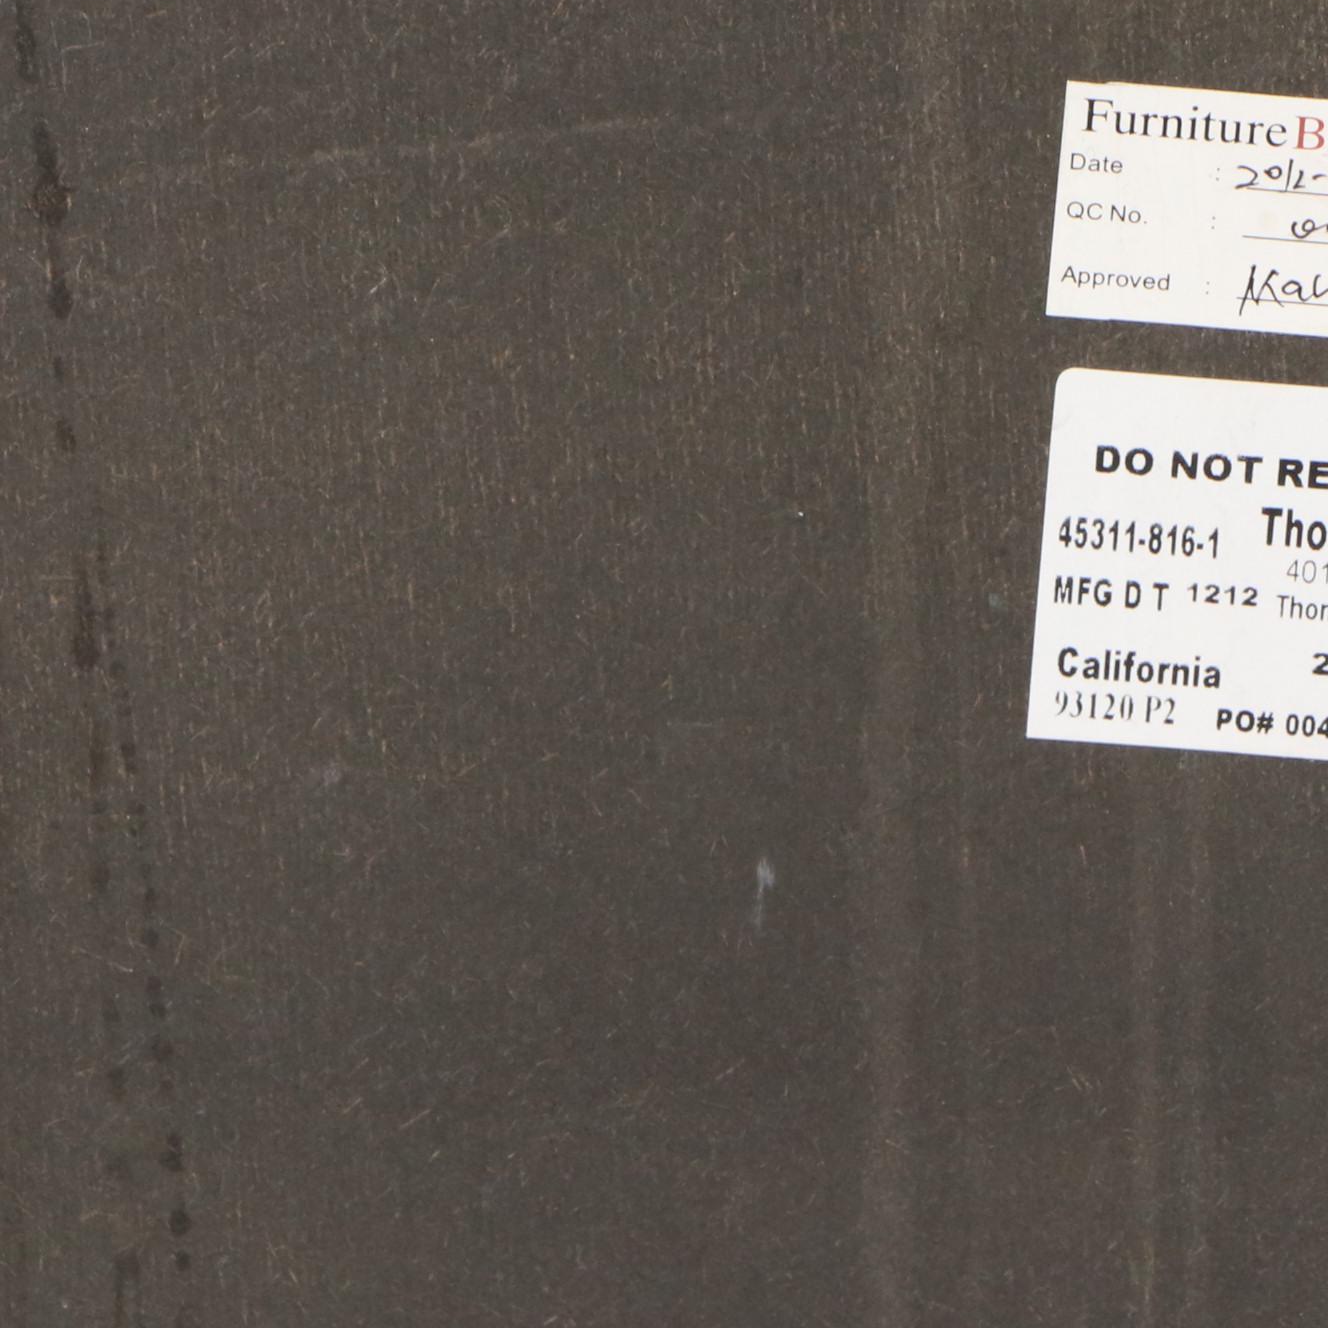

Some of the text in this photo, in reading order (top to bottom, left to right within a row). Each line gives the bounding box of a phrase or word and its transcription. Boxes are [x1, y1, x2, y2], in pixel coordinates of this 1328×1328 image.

[1069, 152, 1125, 175] Date
[1066, 200, 1148, 225] QC No.
[1060, 265, 1172, 291] Approved
[1094, 444, 1154, 474] DO
[1170, 449, 1263, 484] NOT
[1057, 515, 1221, 559] 45311-816-1
[1053, 575, 1113, 607] MFG
[1185, 583, 1259, 608] 1212
[1056, 646, 1222, 690] California
[1053, 690, 1177, 725] 93120 P2
[1215, 708, 1275, 734] PO#
